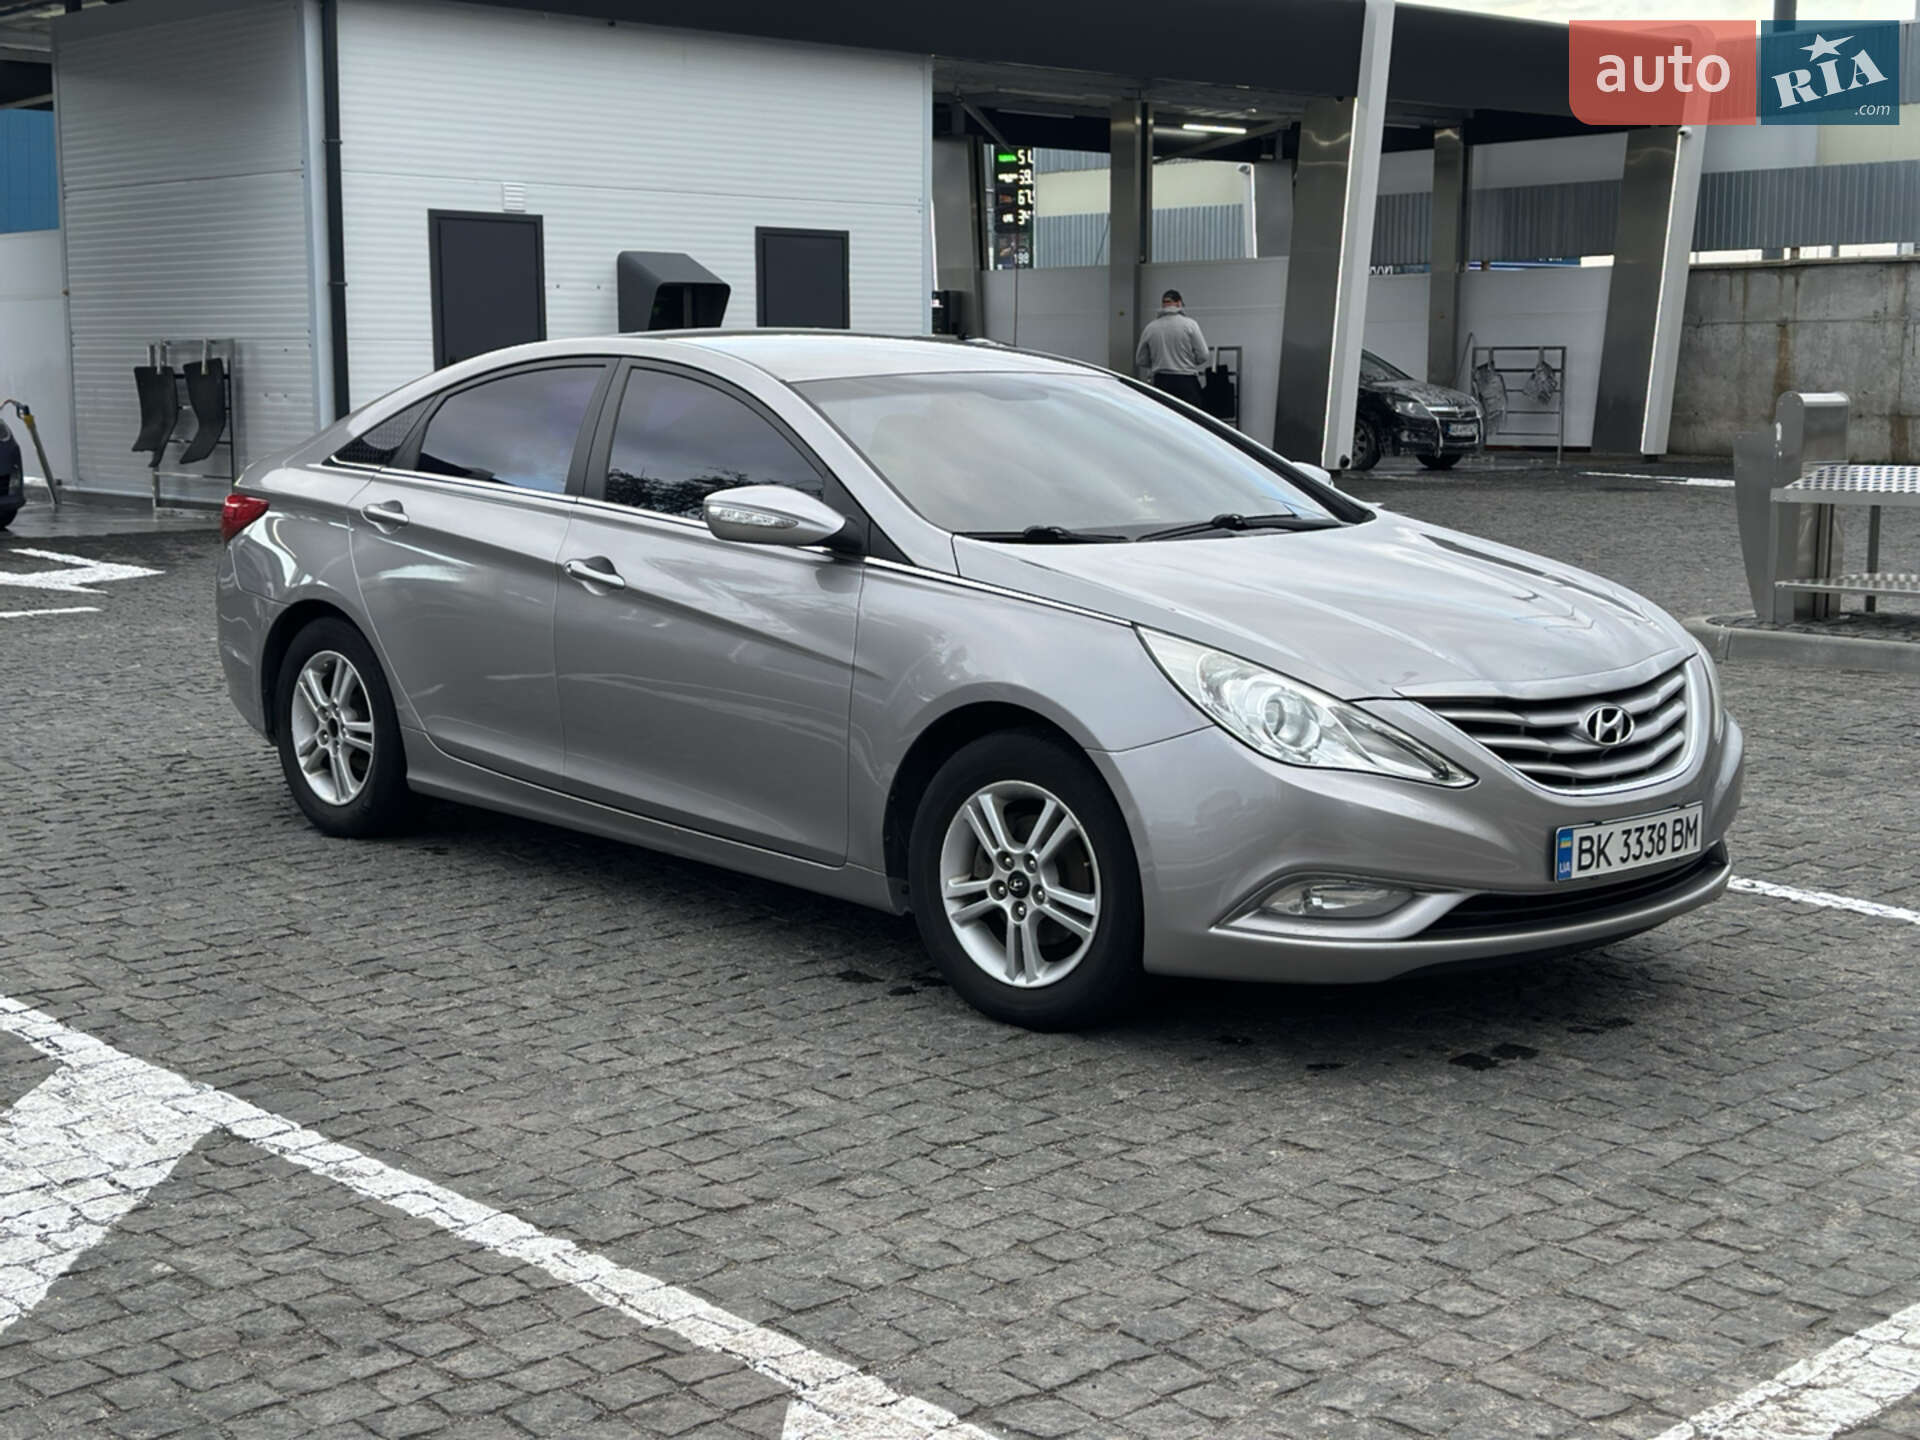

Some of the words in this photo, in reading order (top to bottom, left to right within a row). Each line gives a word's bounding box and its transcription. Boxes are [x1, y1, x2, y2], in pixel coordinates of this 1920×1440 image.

[1577, 832, 1614, 871] BK
[1620, 822, 1668, 863] 3338
[1672, 814, 1699, 852] BM
